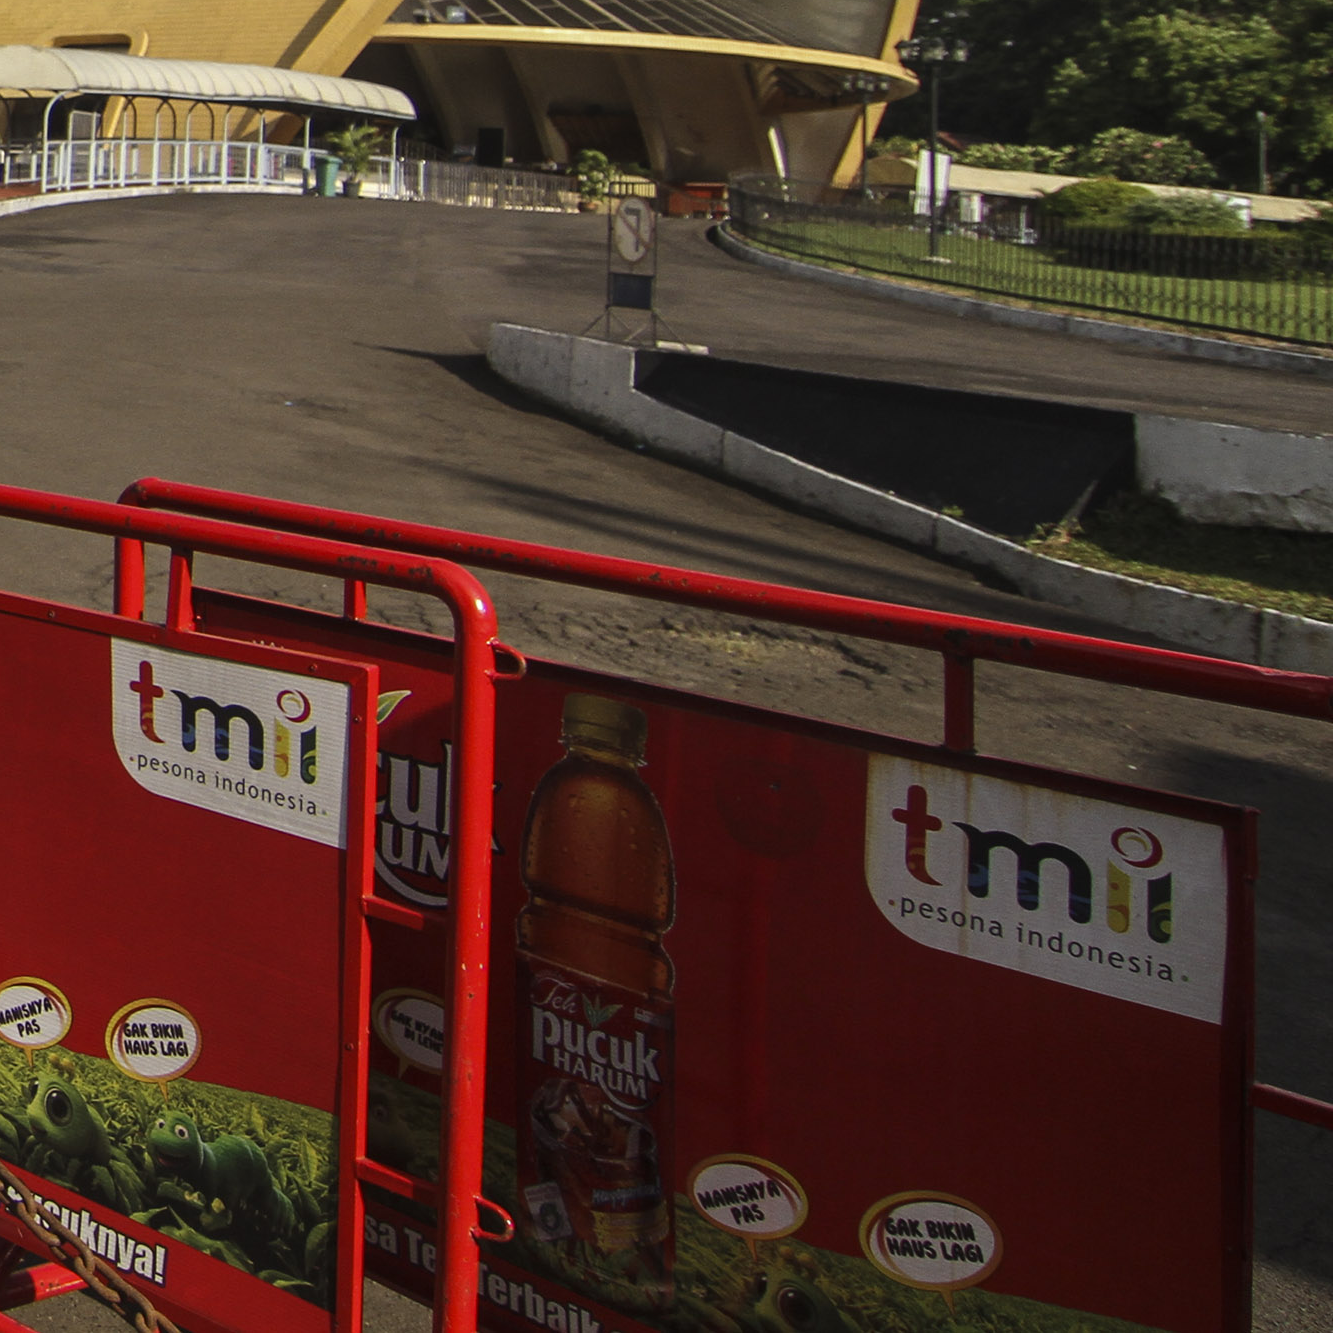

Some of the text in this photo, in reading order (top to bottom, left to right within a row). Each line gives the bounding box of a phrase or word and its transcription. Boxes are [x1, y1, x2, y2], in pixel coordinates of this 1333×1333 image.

[137, 753, 317, 817] pesona indonesia
[900, 896, 1174, 984] pesona indonesia
[16, 1021, 41, 1038] PAS
[123, 1023, 184, 1040] GAK BIKIN
[123, 1039, 190, 1059] HAUS LAGI
[553, 1046, 660, 1111] HARUM
[696, 1178, 782, 1211] MANISNYA
[729, 1202, 766, 1226] PAS
[885, 1217, 976, 1242] GAK BIKIN
[885, 1235, 985, 1265] HAUS LAGI
